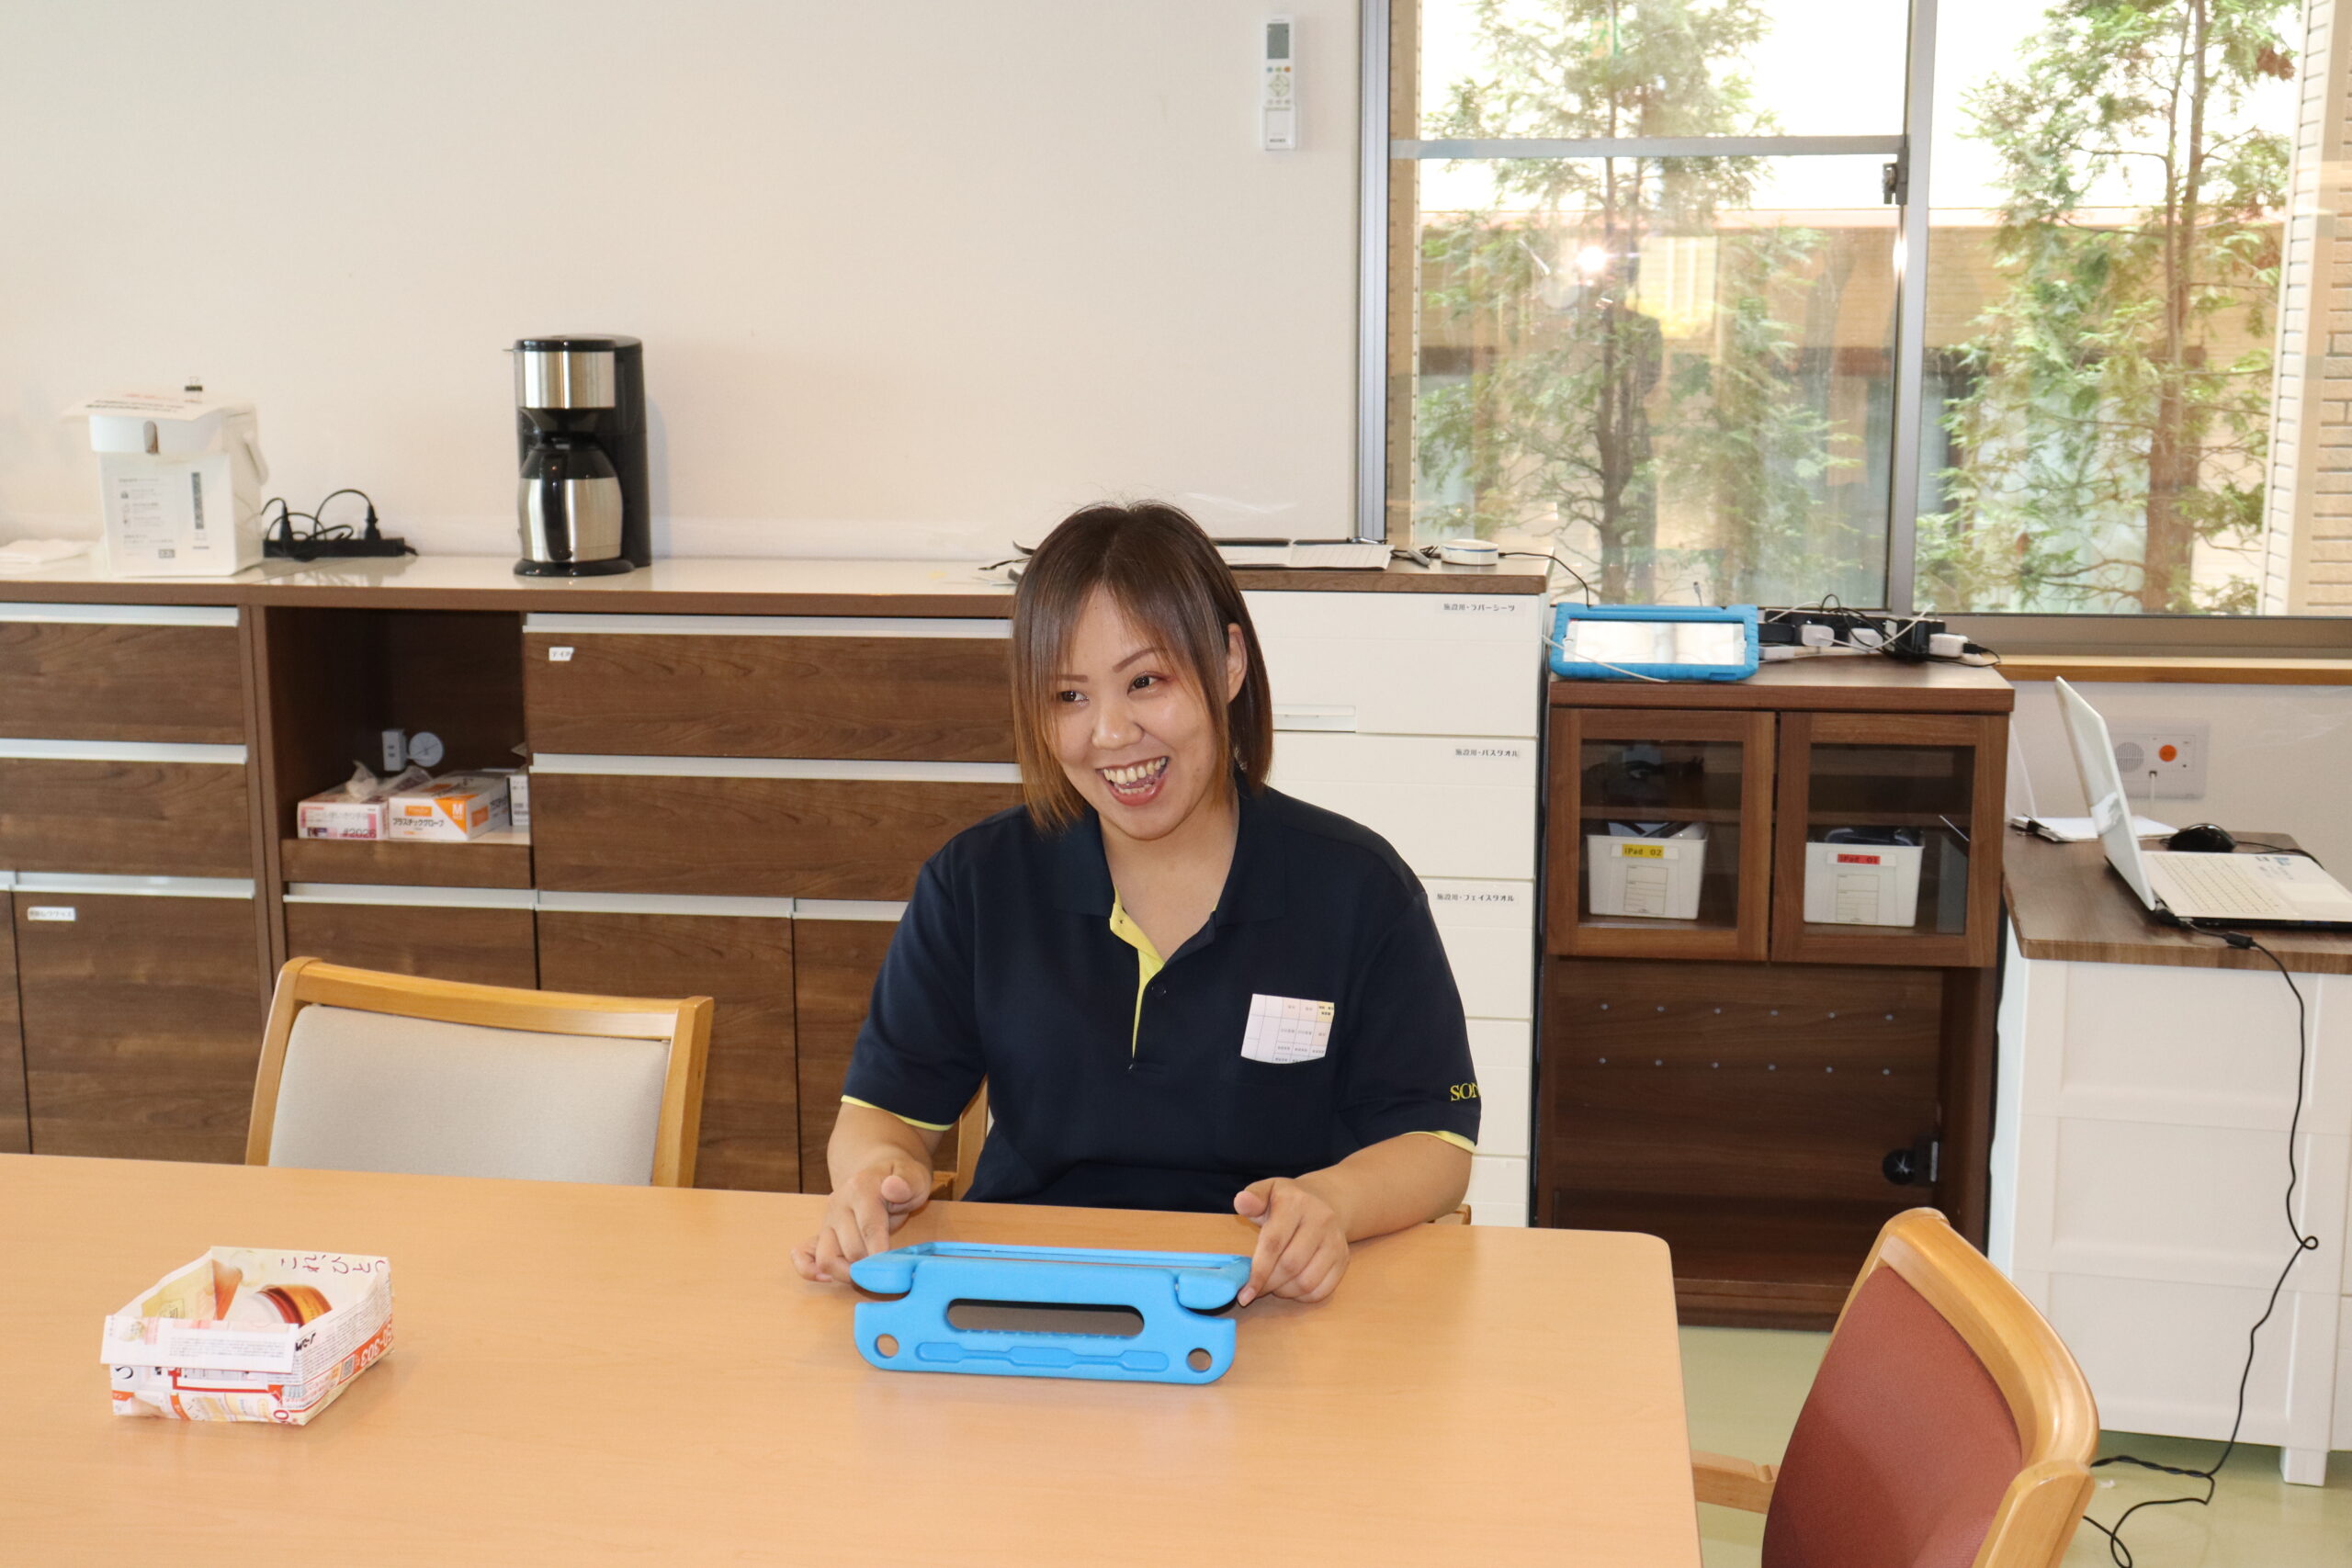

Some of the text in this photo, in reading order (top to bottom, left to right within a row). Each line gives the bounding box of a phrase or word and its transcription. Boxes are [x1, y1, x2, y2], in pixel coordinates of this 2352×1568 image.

[452, 803, 463, 816] M
[1624, 847, 1662, 856] iPad 02
